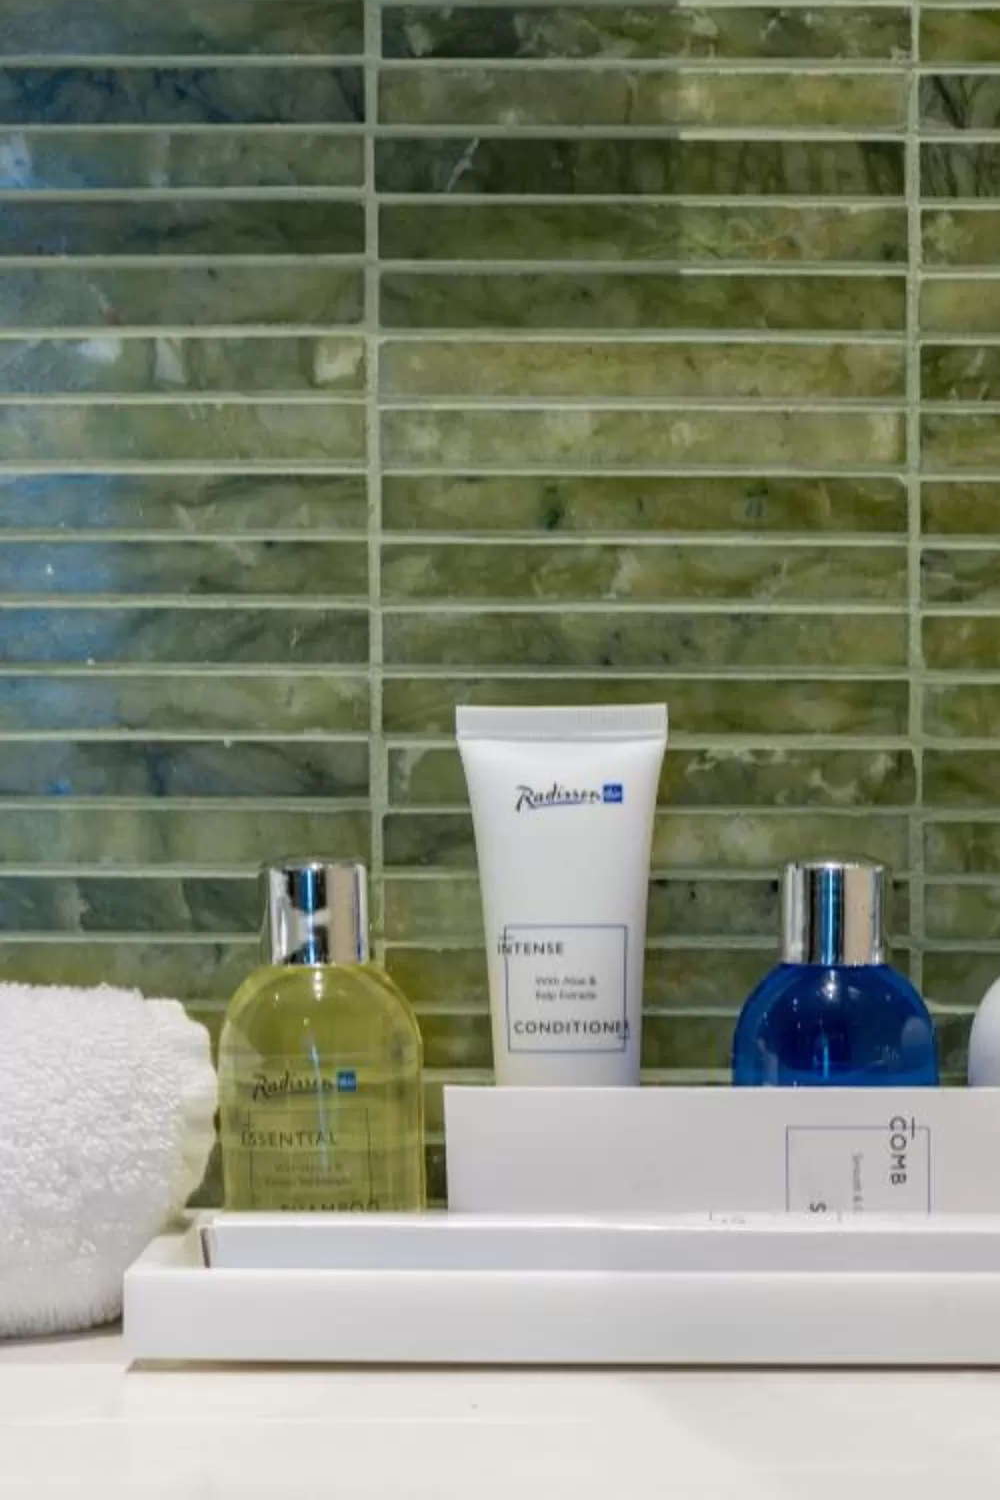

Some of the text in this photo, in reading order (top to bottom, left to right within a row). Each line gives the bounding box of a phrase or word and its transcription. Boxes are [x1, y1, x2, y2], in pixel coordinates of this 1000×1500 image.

[515, 780, 601, 812] Radisson
[497, 941, 564, 956] INTENSE
[889, 1115, 907, 1185] COMB
